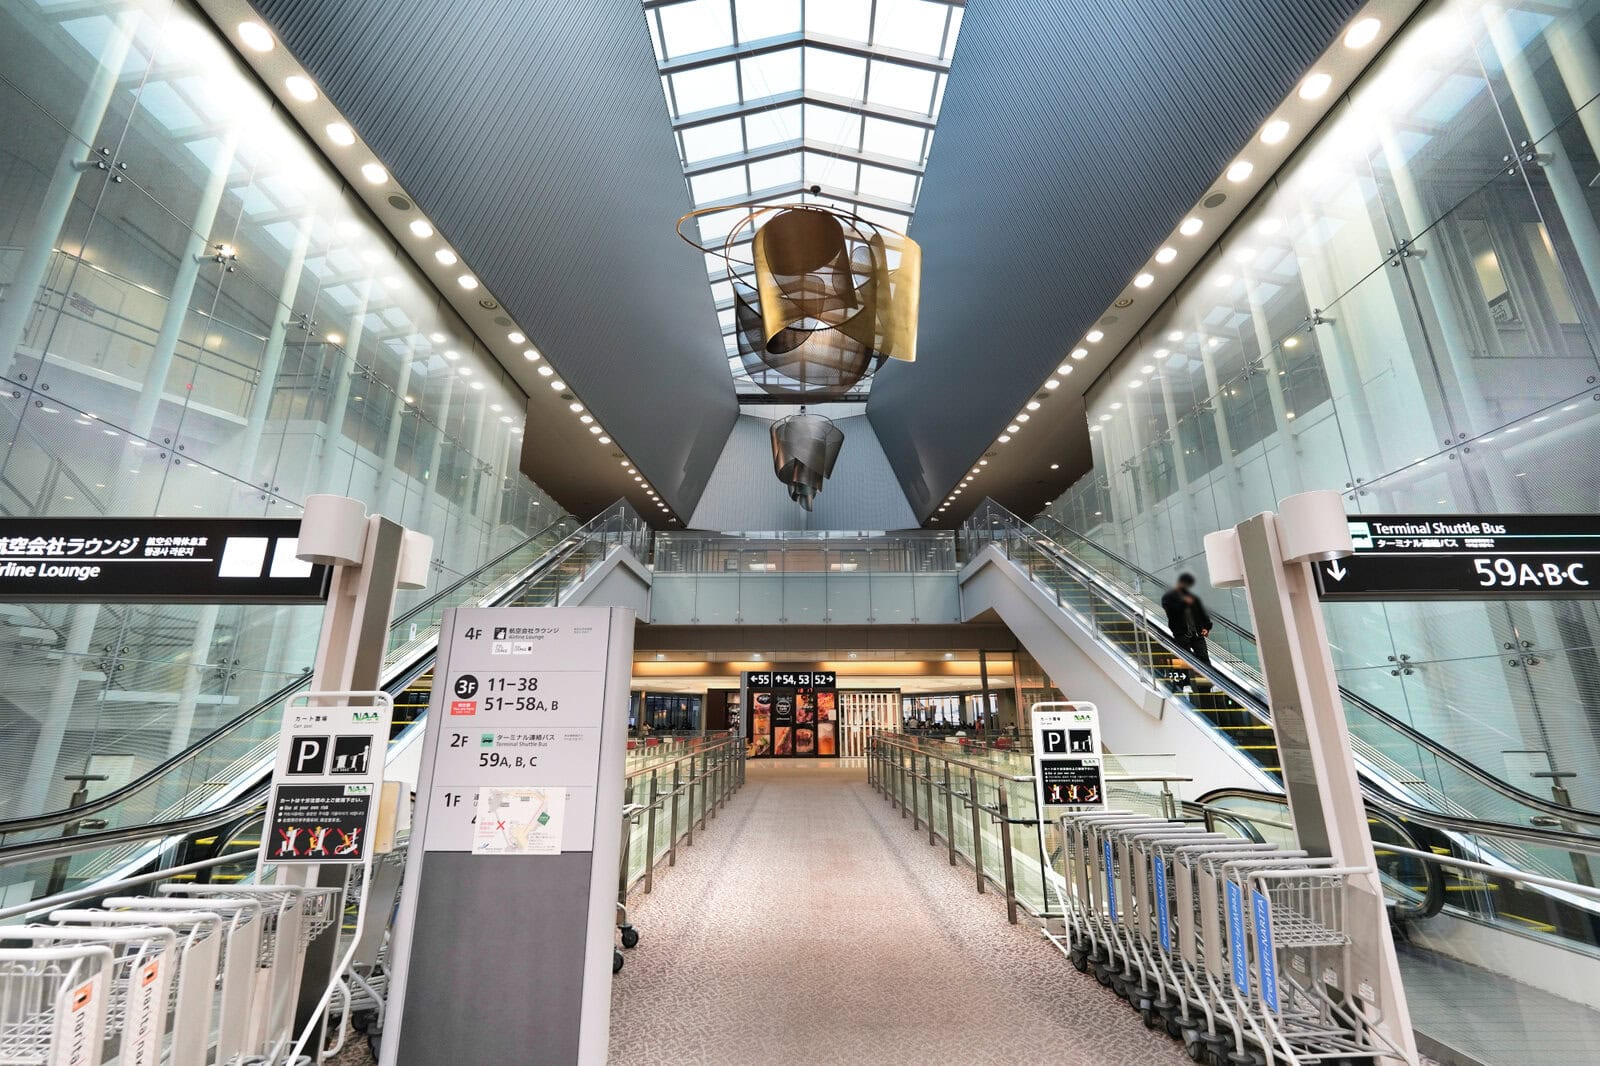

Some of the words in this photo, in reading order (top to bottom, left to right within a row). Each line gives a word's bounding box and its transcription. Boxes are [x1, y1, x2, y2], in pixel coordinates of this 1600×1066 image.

[1373, 522, 1431, 535] Terminal
[1433, 522, 1479, 535] Shuttle
[1481, 522, 1506, 535] Bus
[0, 562, 36, 578] rline
[39, 563, 101, 581] Lounge
[464, 627, 482, 640] 4F
[758, 674, 769, 684] 55
[782, 674, 797, 685] 54,
[798, 674, 809, 684] 53
[815, 674, 826, 684] 52
[457, 680, 476, 694] 3F
[551, 700, 559, 711] B
[450, 733, 469, 747] 2F
[1048, 732, 1060, 751] P
[296, 740, 320, 772] P
[515, 756, 526, 768] B,
[529, 756, 538, 767] C
[444, 792, 461, 807] 1F
